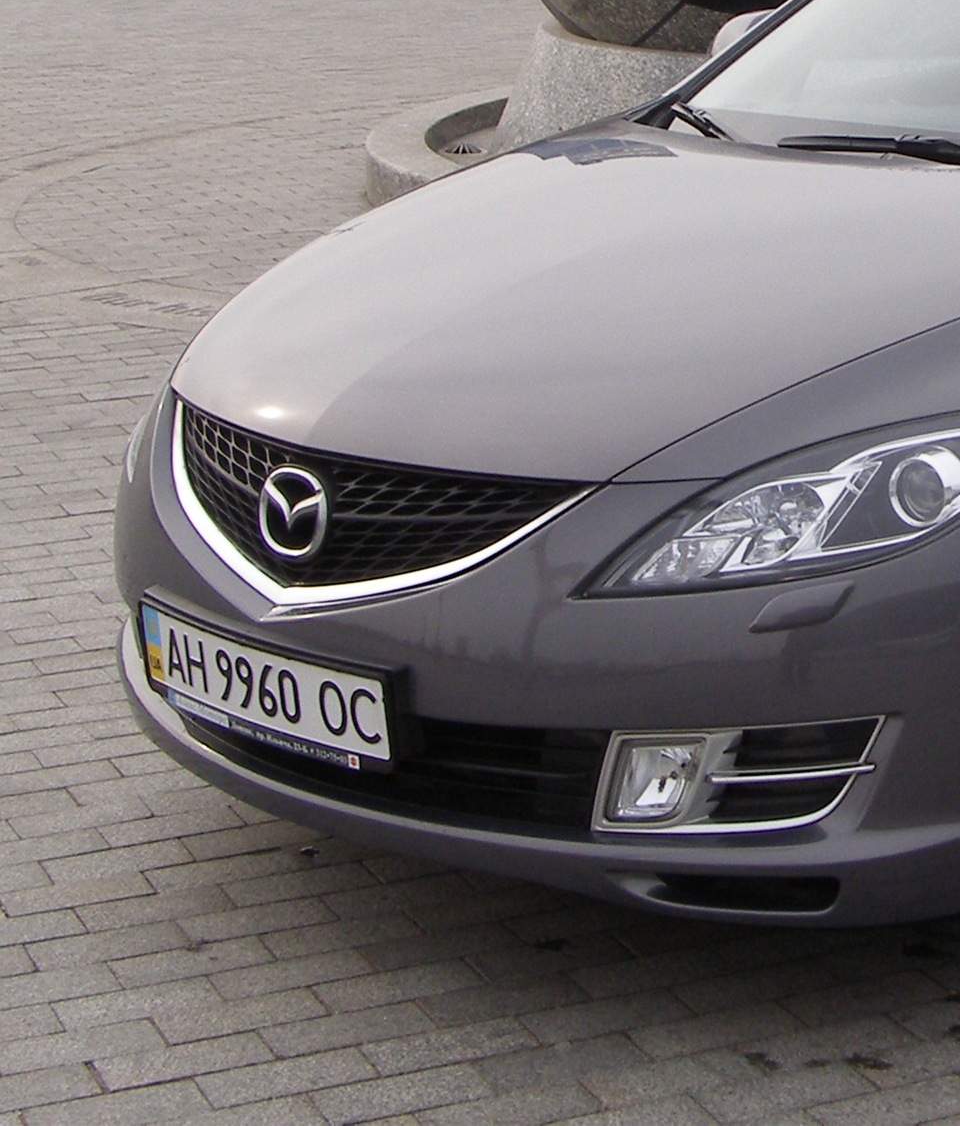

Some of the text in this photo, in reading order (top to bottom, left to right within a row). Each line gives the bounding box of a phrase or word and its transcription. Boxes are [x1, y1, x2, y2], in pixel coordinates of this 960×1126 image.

[168, 627, 209, 694] AH
[215, 648, 301, 724] 9960
[319, 680, 382, 744] OC
